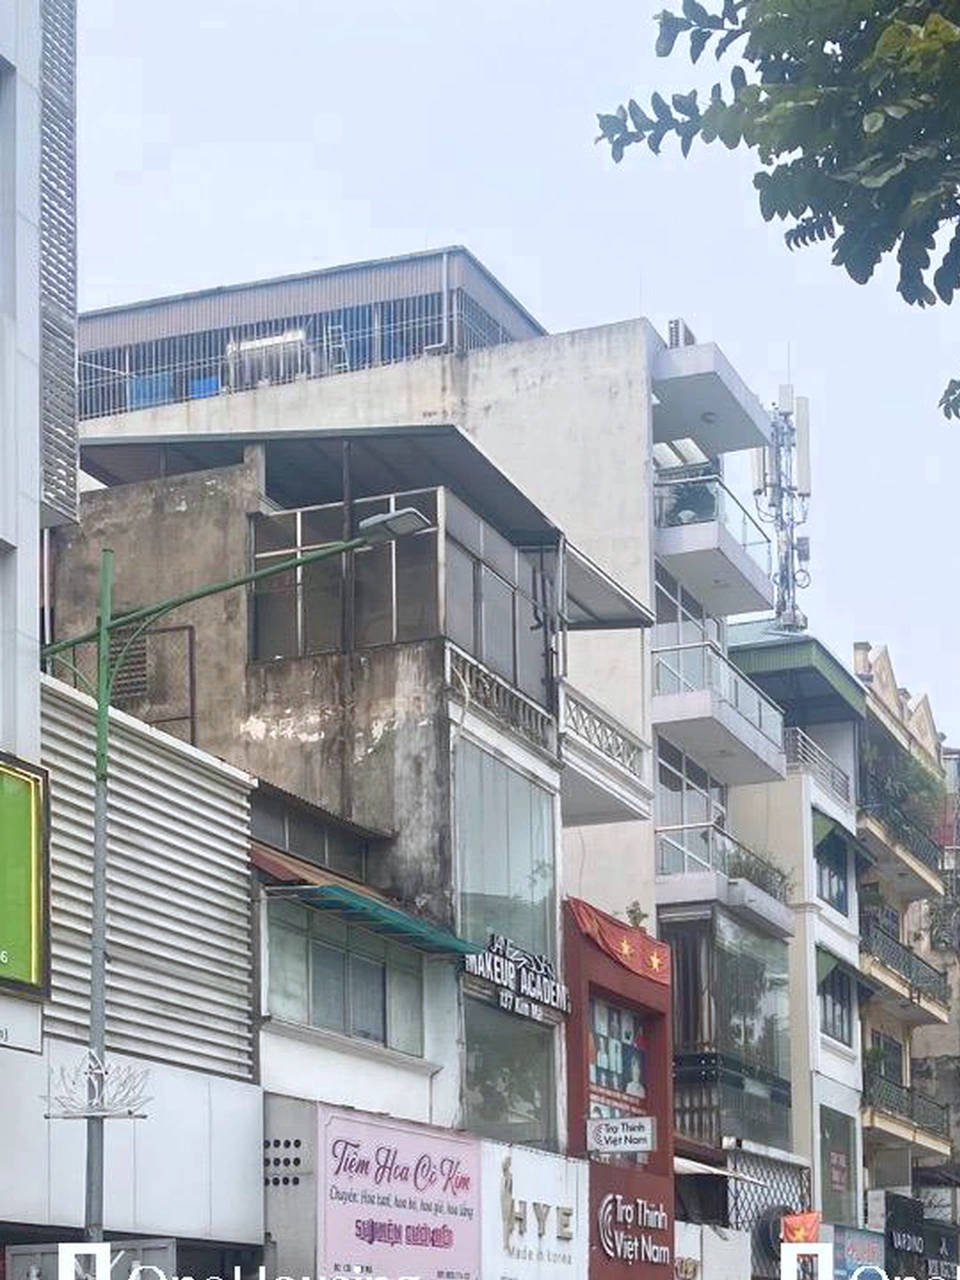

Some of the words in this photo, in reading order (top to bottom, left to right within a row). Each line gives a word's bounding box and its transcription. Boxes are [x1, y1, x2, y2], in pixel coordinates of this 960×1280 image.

[465, 952, 517, 992] MAKEUP
[624, 1135, 648, 1145] Nam
[332, 1139, 370, 1179] Tiệm
[374, 1146, 410, 1185] Hoa
[440, 1158, 471, 1196] Kim
[615, 1193, 635, 1229] Trợ
[614, 1229, 639, 1266] Việt
[641, 1233, 670, 1265] Nam
